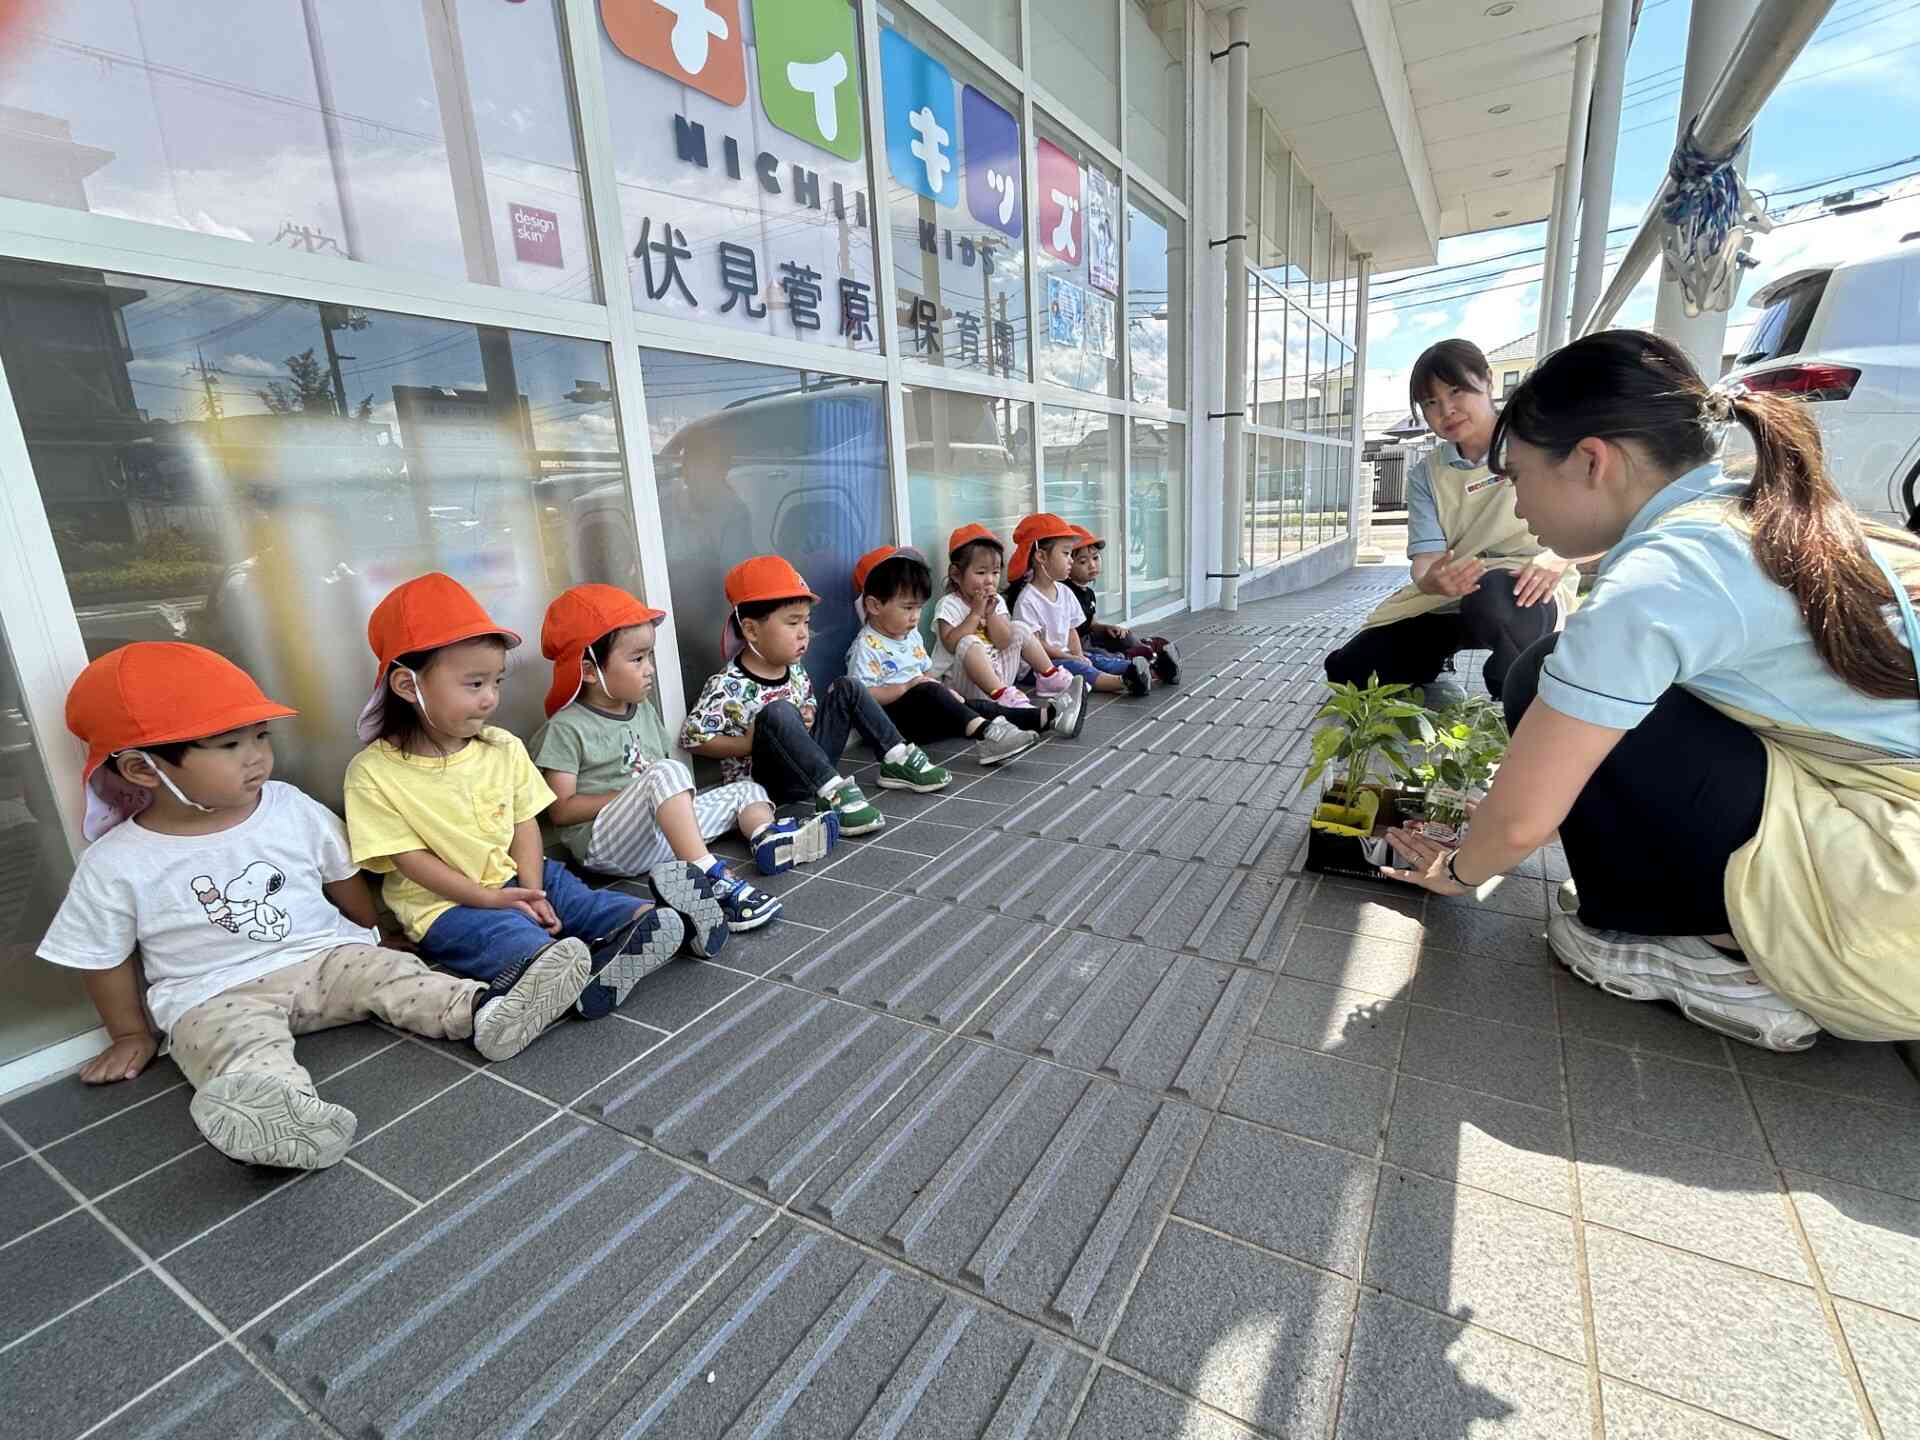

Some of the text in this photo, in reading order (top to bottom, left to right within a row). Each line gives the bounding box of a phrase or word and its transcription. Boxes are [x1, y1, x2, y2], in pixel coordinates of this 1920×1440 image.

[674, 113, 995, 275] NICHII KIDS
[514, 208, 554, 232] design
[518, 224, 543, 242] skin
